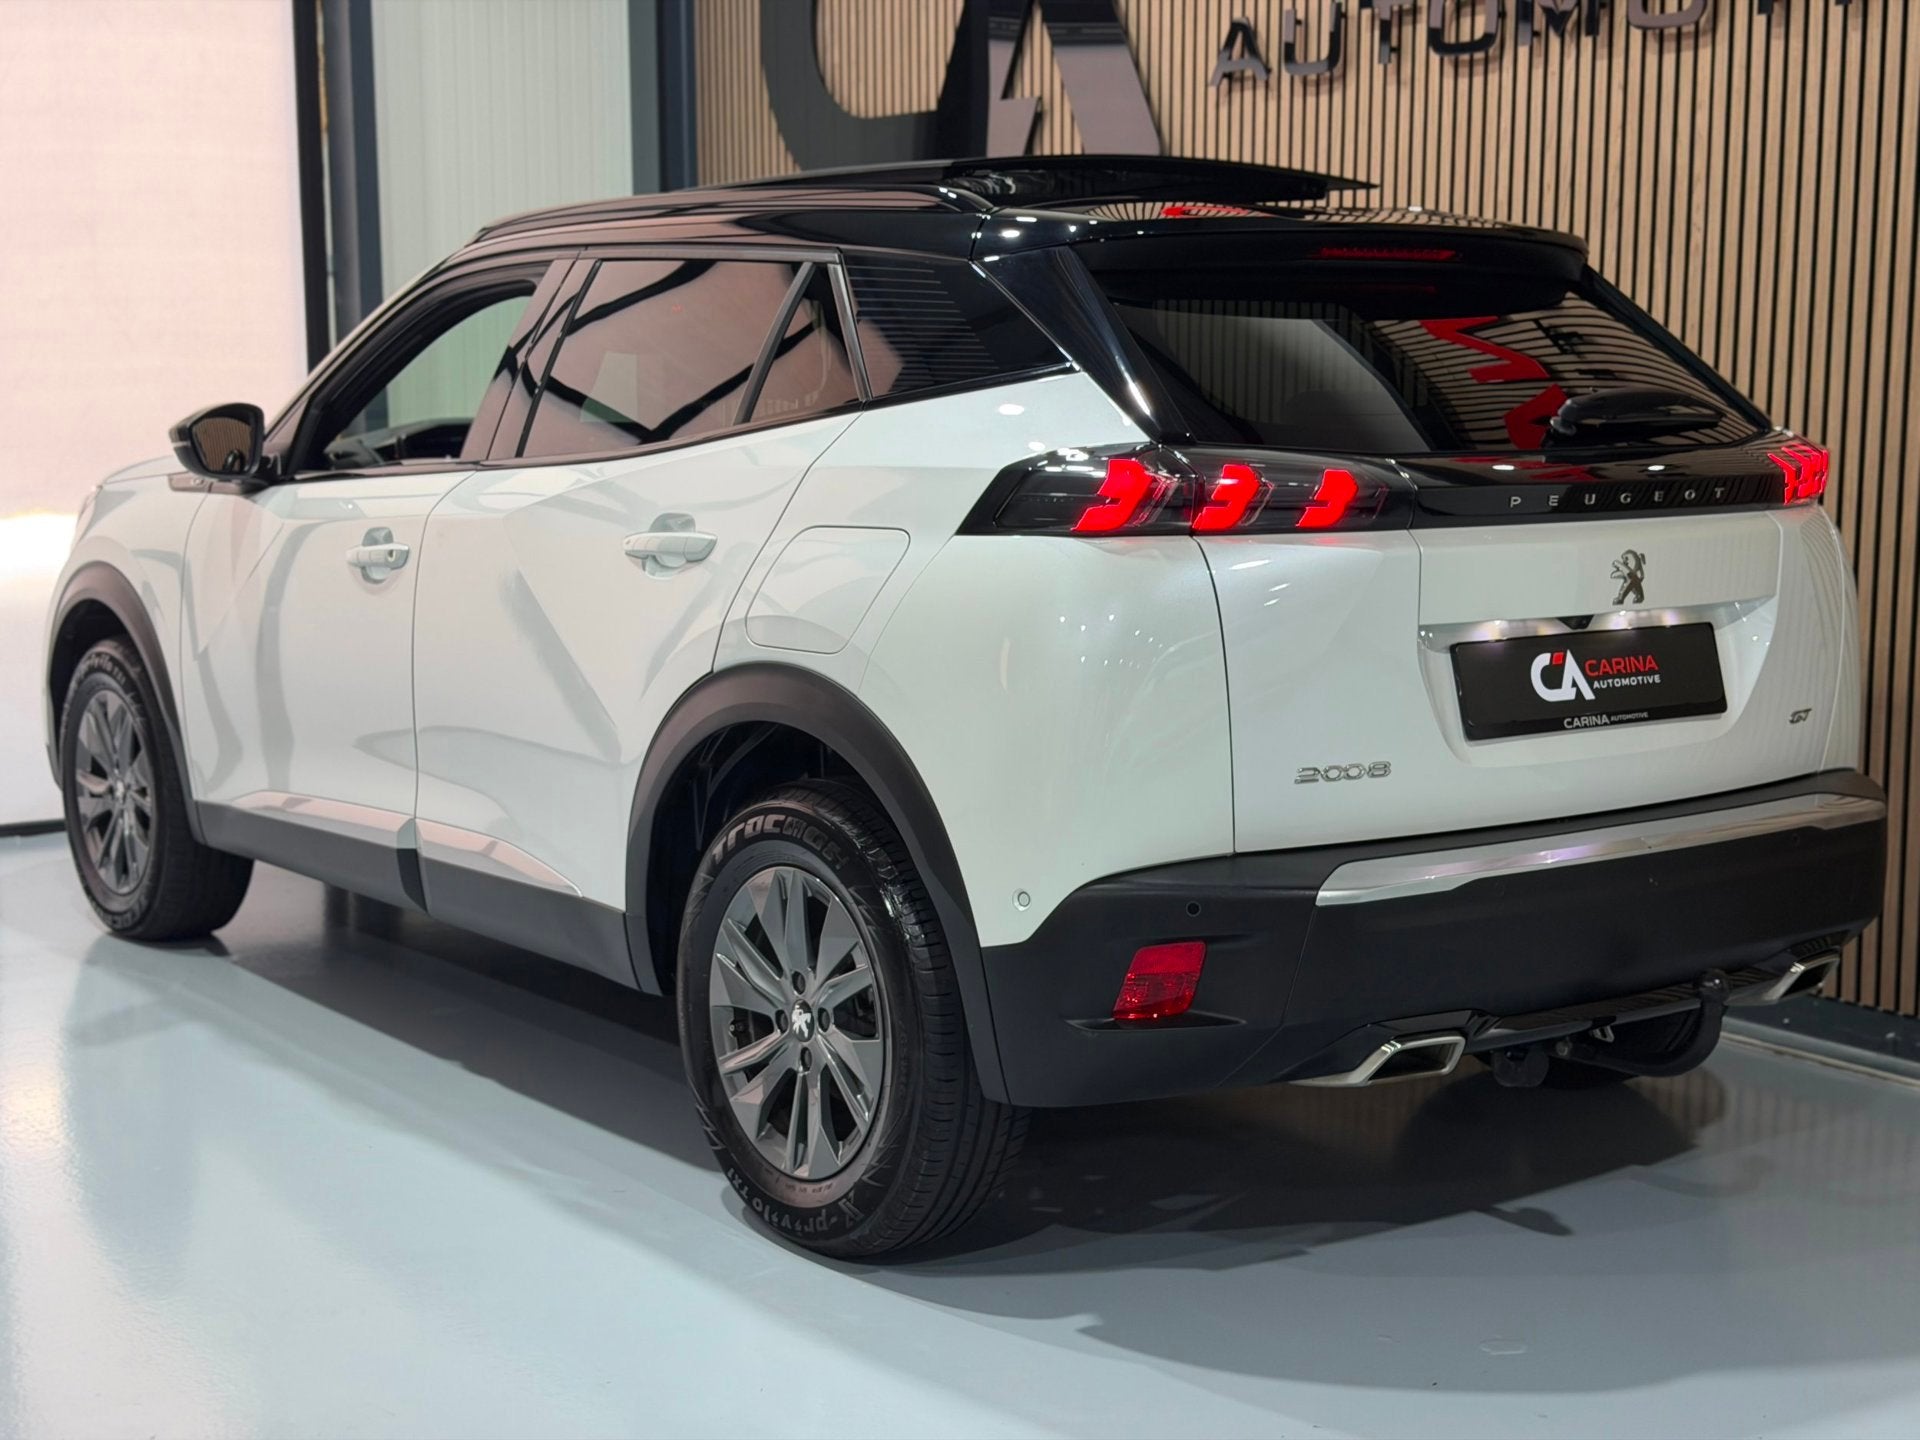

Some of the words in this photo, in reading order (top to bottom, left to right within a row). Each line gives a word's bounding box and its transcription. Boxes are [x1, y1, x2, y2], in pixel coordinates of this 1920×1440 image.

[1509, 487, 1725, 509] PEUGEOT
[1584, 654, 1659, 677] CARINA
[1592, 673, 1662, 690] AUTOMOTIVE
[1563, 713, 1610, 729] CARINA
[1610, 711, 1649, 722] AUTOMOTIVE
[1294, 761, 1391, 784] 2008
